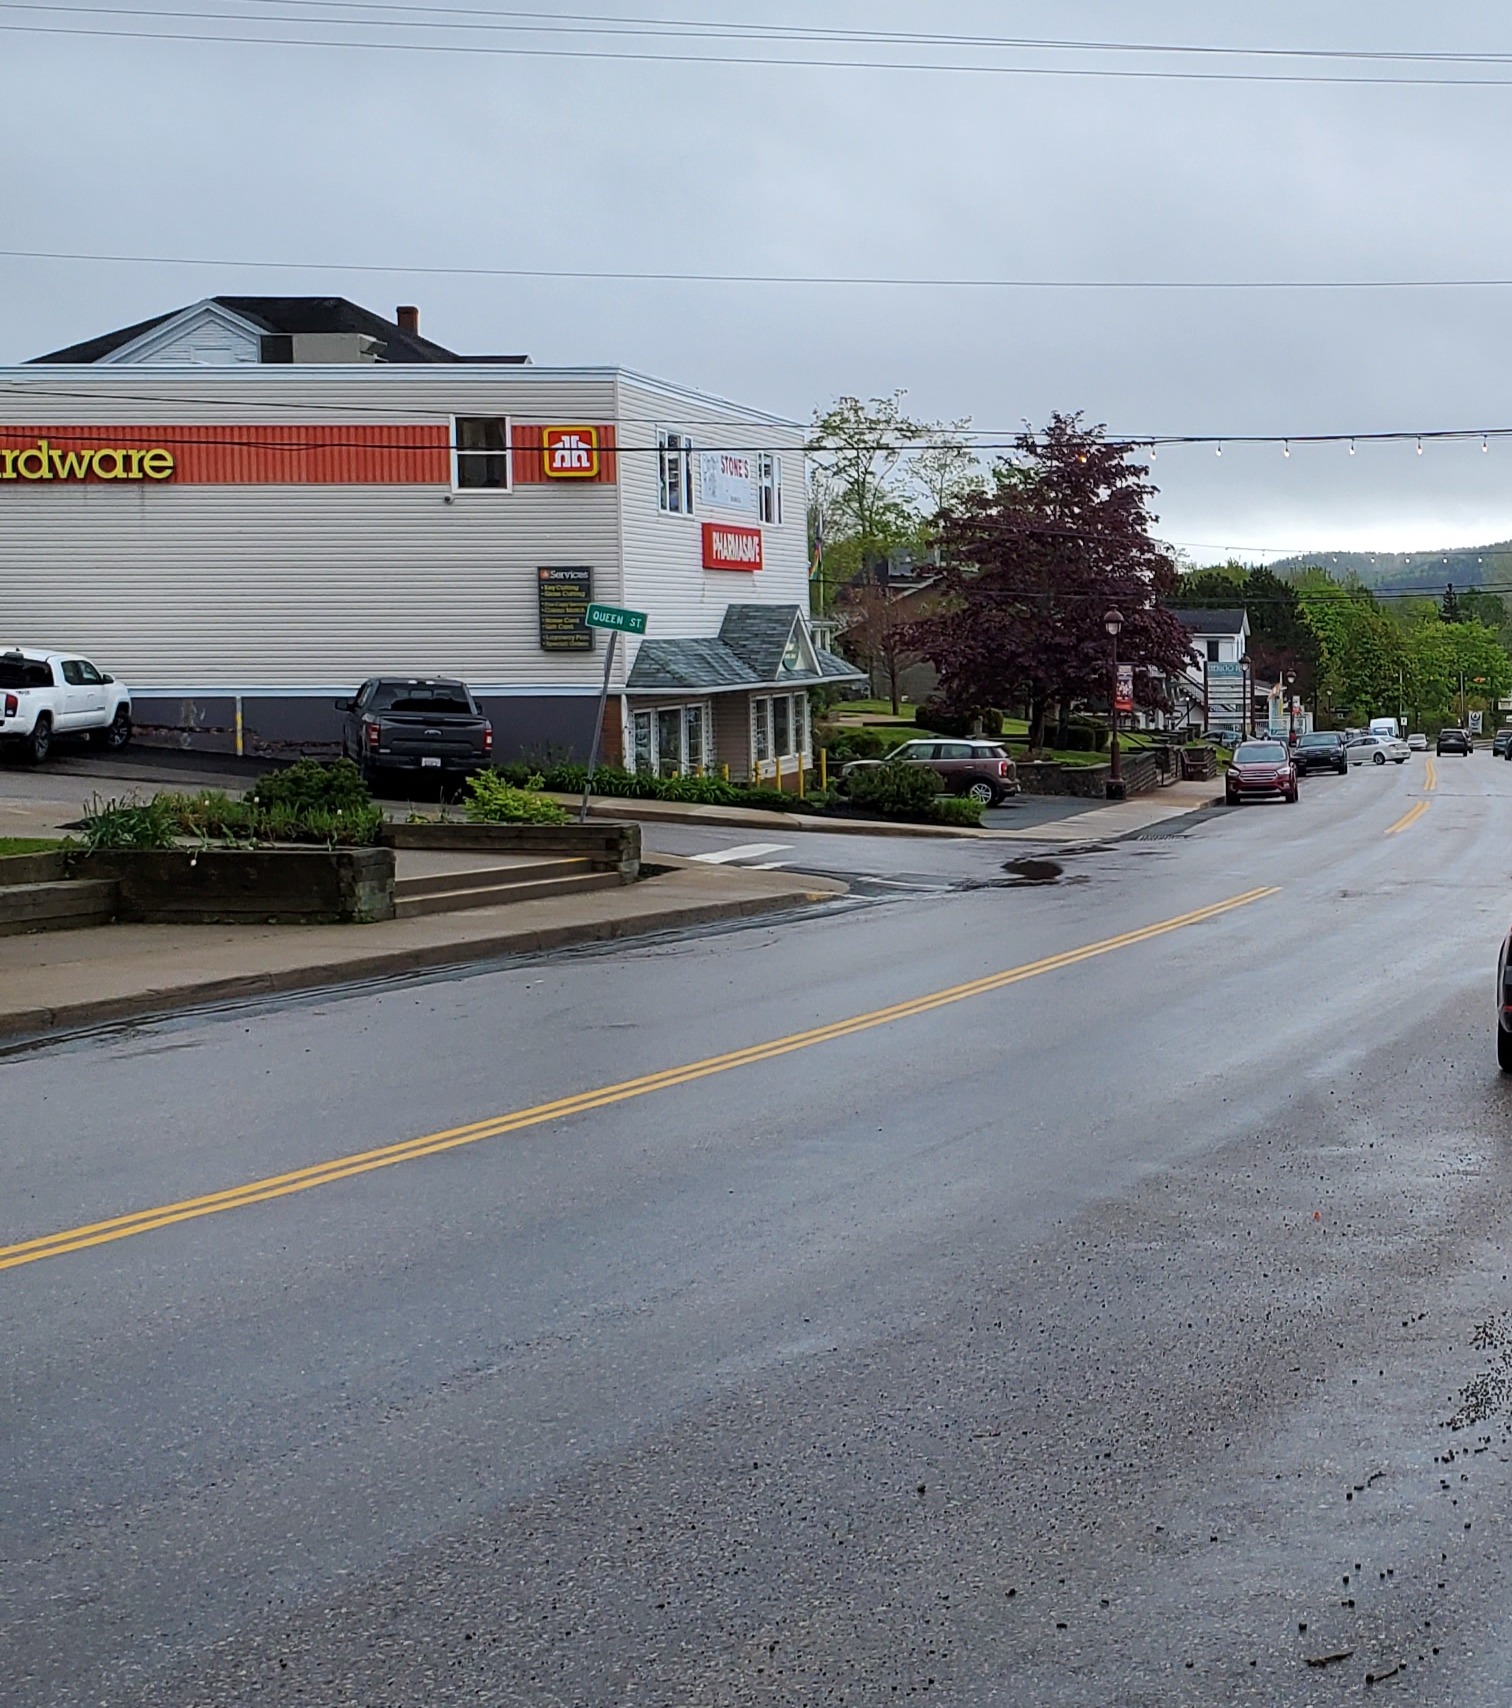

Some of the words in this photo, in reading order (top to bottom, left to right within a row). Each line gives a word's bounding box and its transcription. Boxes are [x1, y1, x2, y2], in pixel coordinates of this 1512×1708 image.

[0, 439, 174, 479] rdware
[712, 531, 760, 563] PHARMASAVE
[550, 570, 589, 579] Services
[593, 611, 624, 625] QUEEN
[629, 618, 641, 628] ST
